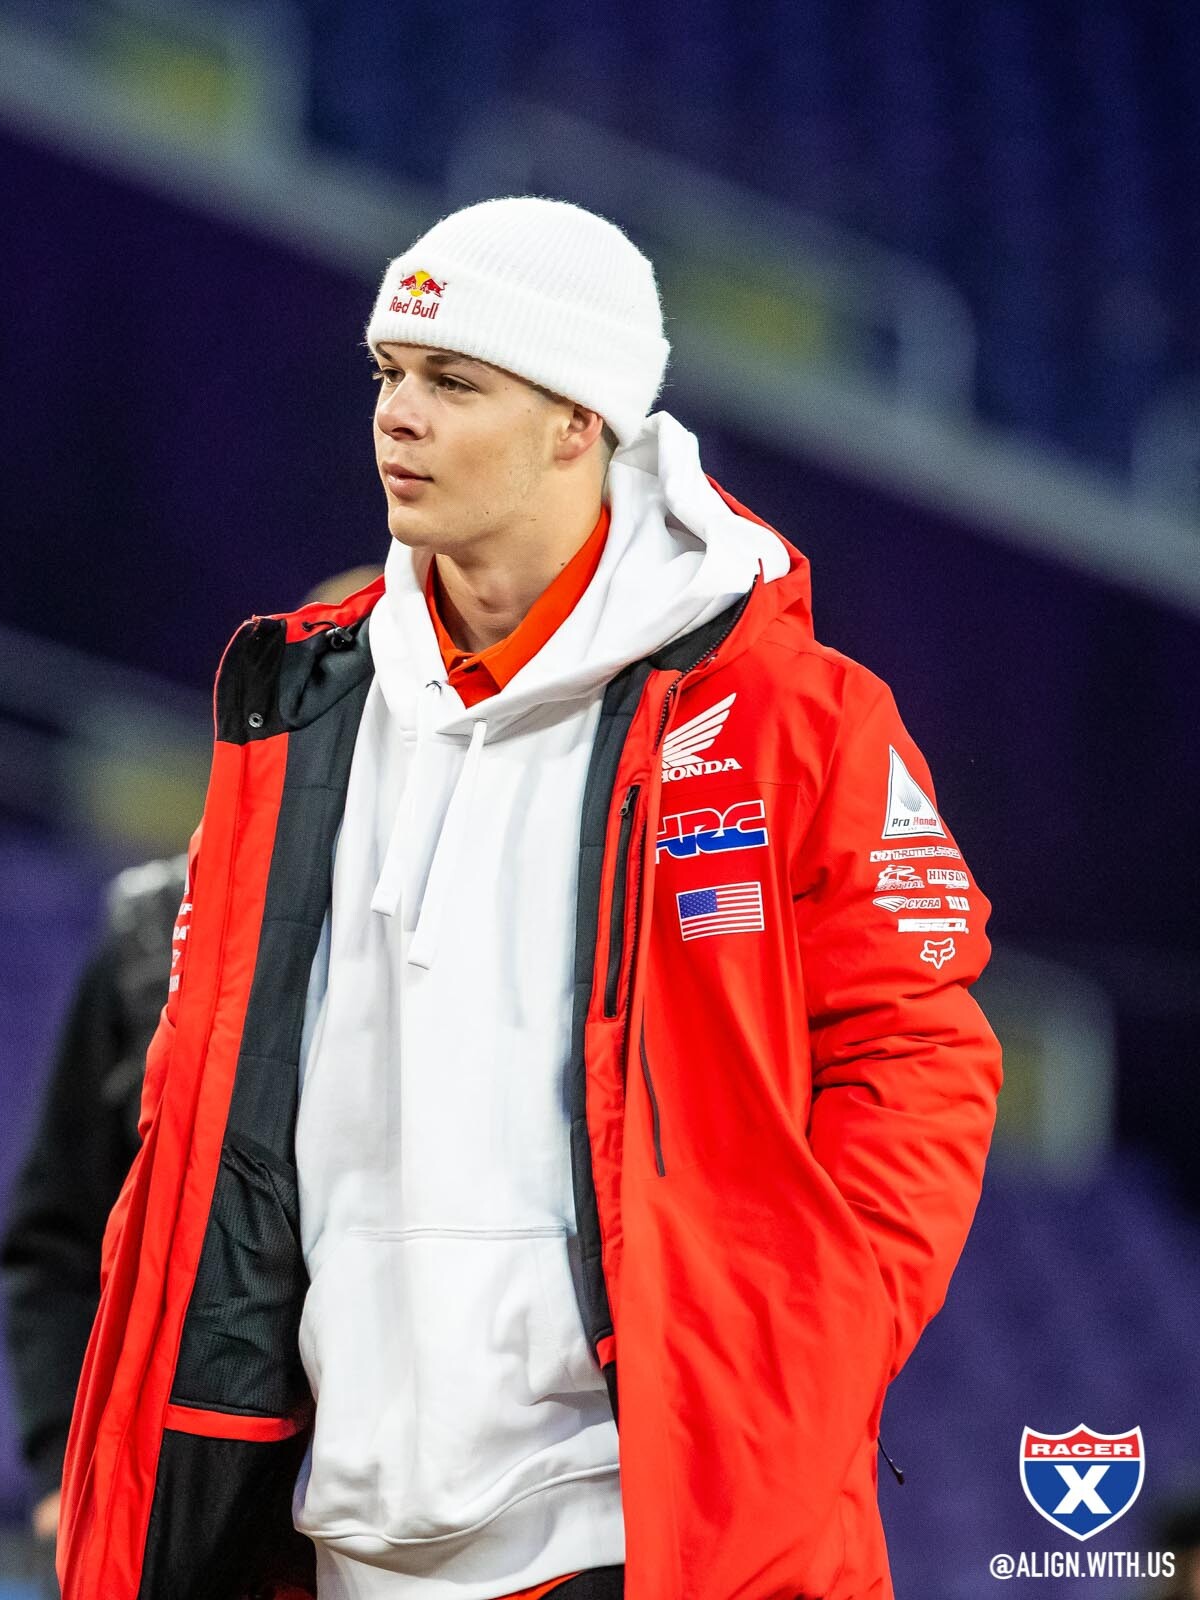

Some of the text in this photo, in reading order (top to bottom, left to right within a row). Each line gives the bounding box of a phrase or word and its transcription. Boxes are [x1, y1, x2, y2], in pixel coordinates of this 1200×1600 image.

[389, 296, 439, 320] Red Bull
[892, 816, 937, 827] Pro Honda
[928, 870, 967, 882] HINSON
[907, 899, 940, 909] CYCRA
